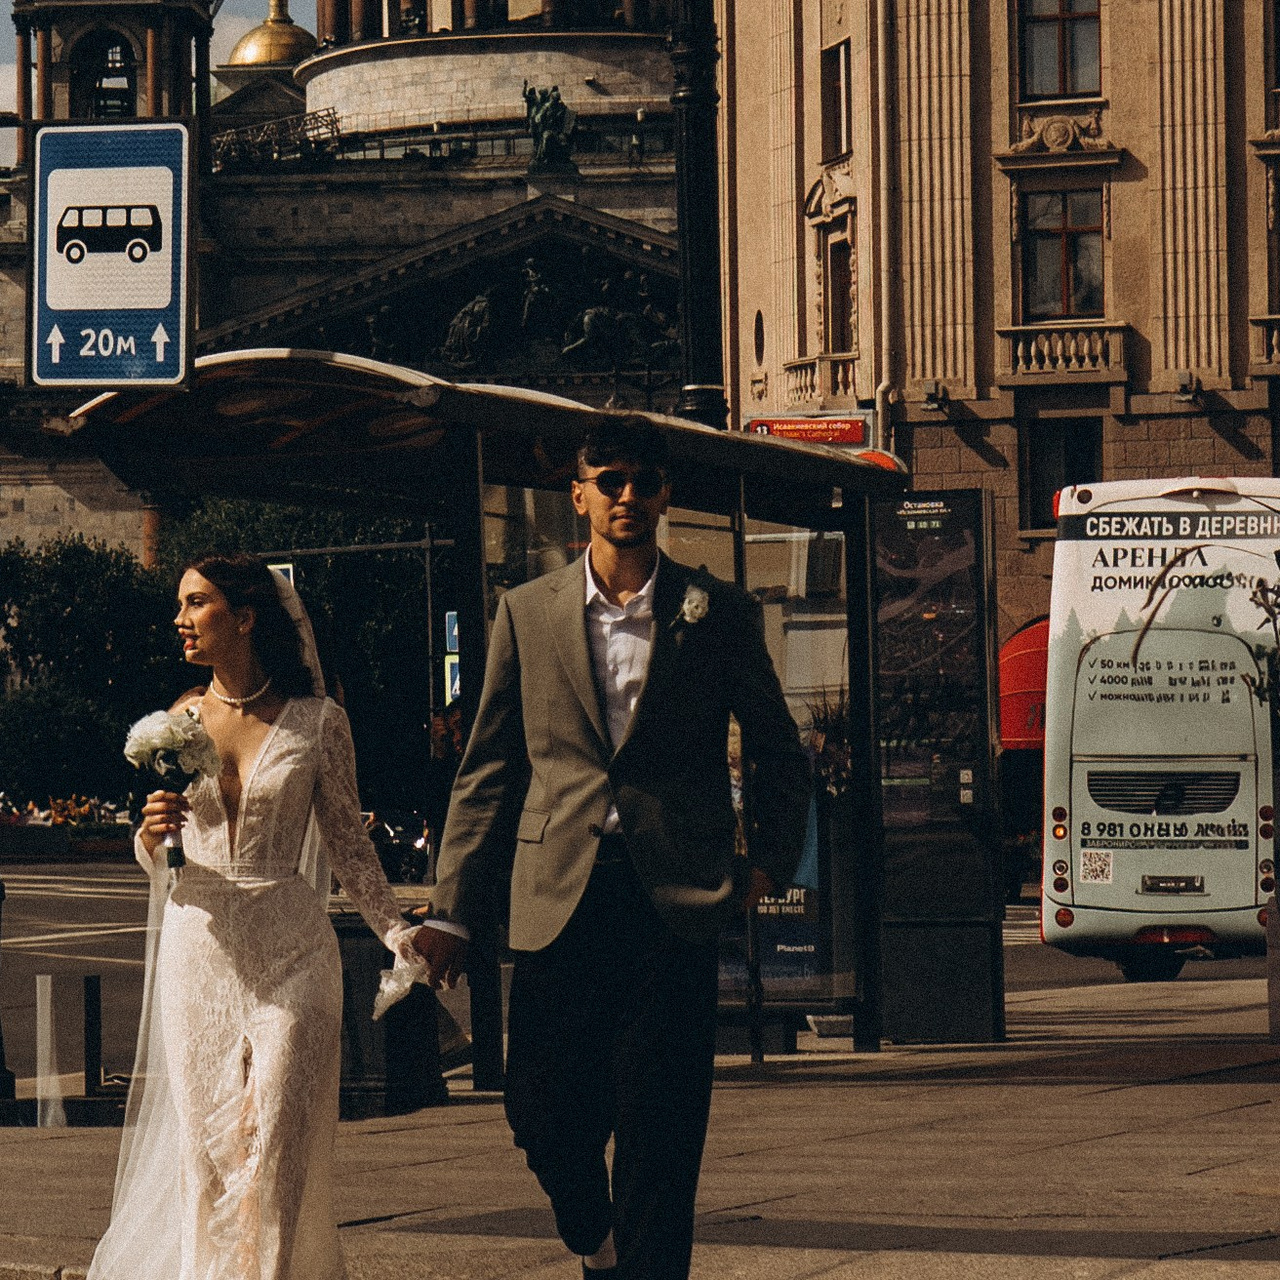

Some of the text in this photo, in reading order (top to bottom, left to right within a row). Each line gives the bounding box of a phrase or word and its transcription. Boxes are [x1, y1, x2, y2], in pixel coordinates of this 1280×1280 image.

[1086, 516, 1173, 537] СБЕЖАТЬ
[1179, 517, 1191, 536] В
[1100, 659, 1113, 669] 50
[1100, 675, 1129, 685] 4000
[1081, 821, 1092, 837] 8
[1096, 822, 1124, 837] 981
